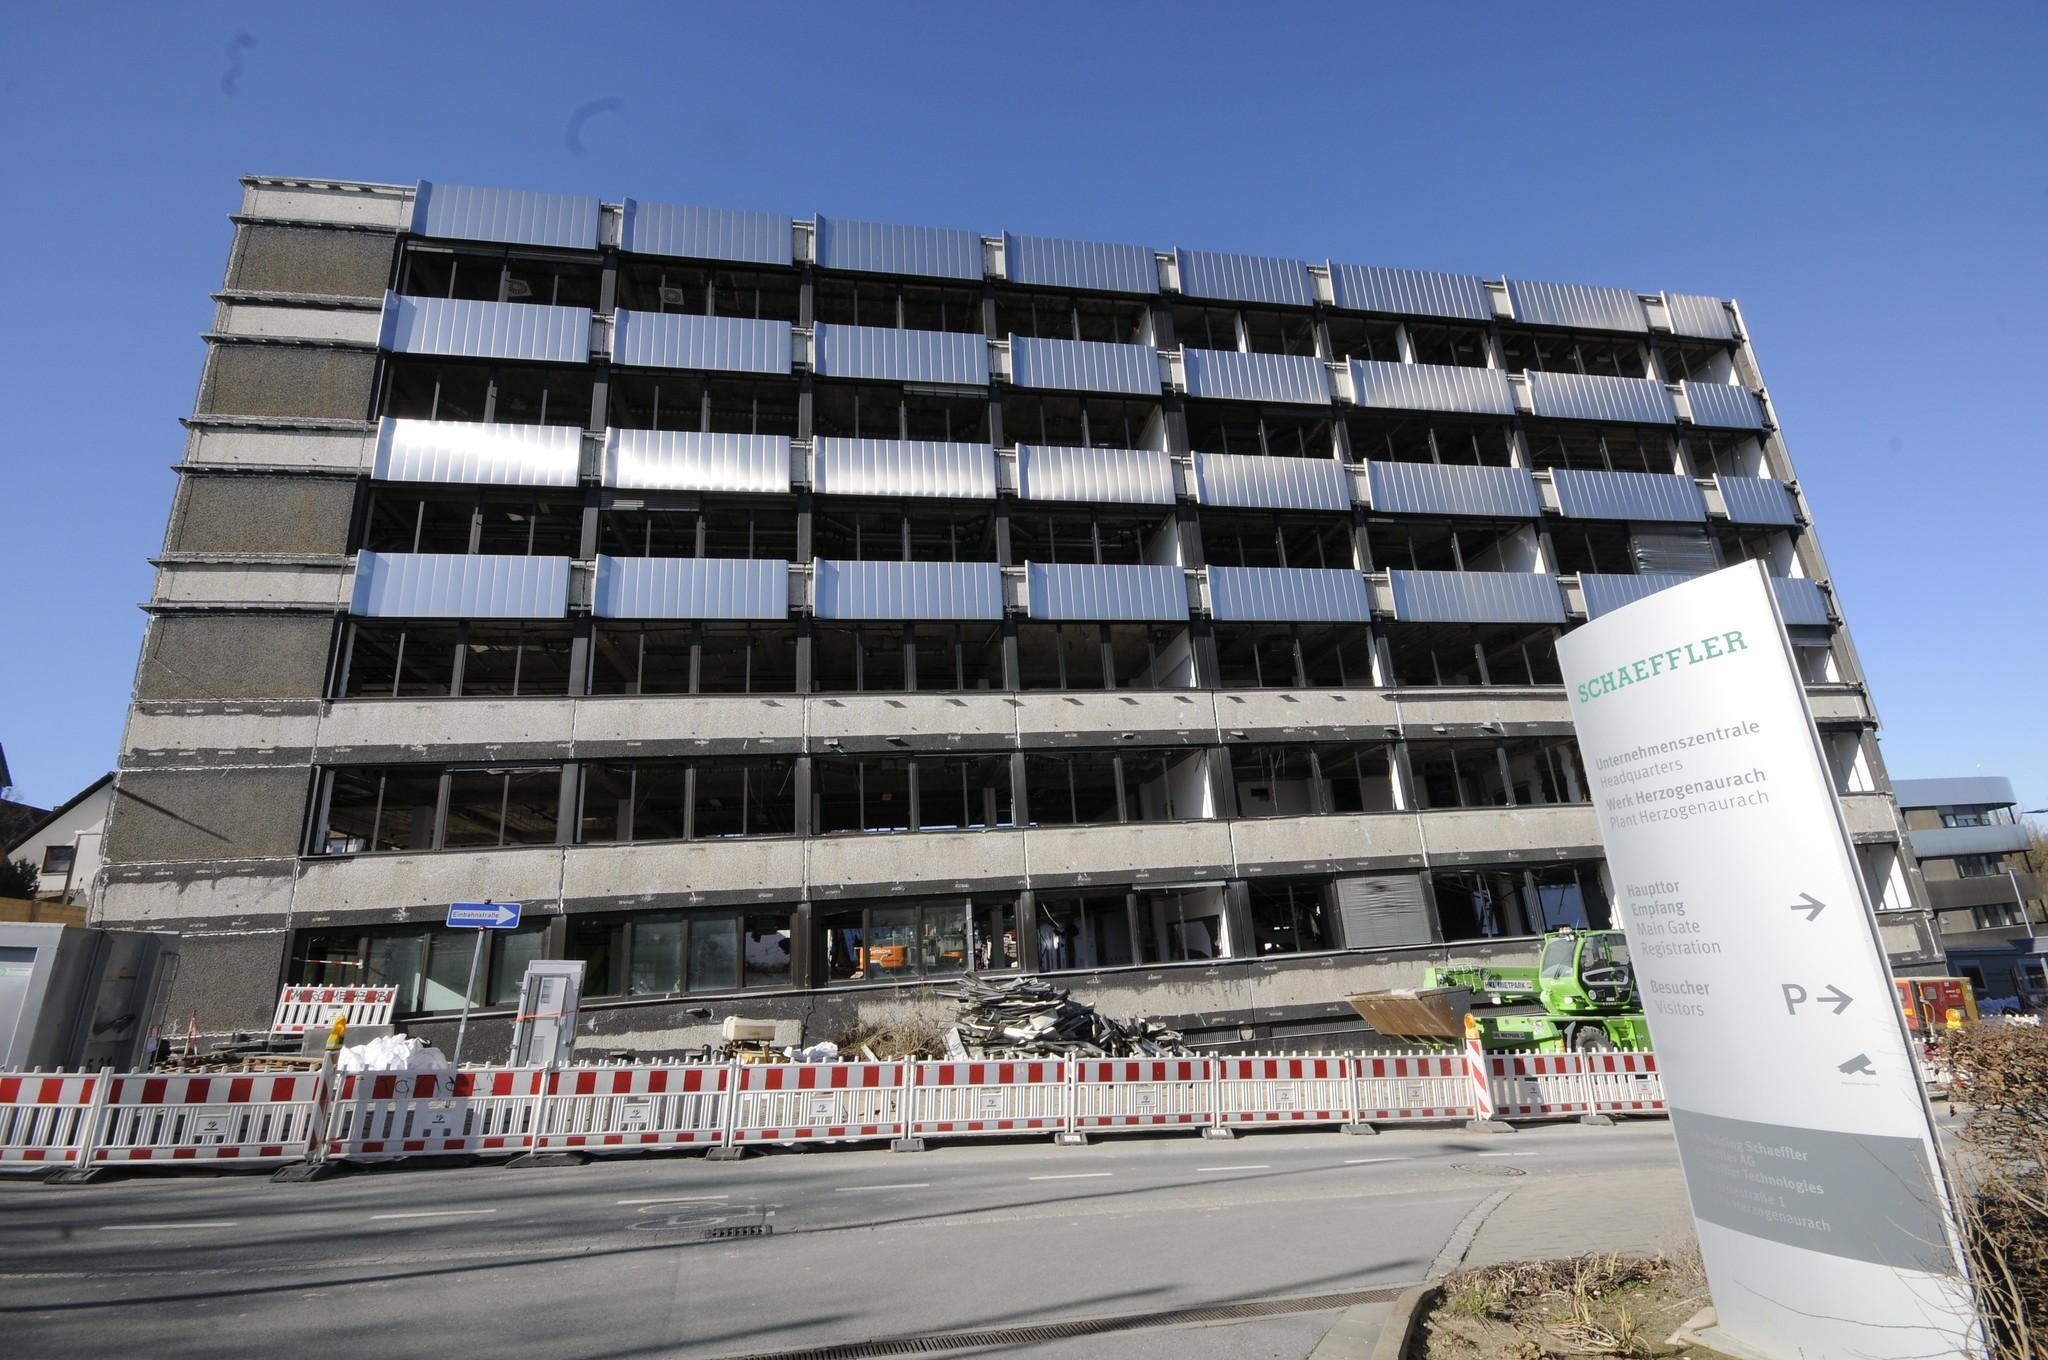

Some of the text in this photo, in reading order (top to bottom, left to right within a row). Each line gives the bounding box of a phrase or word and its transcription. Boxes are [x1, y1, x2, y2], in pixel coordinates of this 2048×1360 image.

[1578, 630, 1748, 704] SCHAEFFLER
[1595, 720, 1761, 771] Unternehmenszentrale
[1600, 759, 1684, 789] Headquarters
[1606, 768, 1767, 811] Werk Herzogenaurach
[1610, 790, 1770, 830] Plant Herzogenaurach
[1626, 880, 1680, 898] Haupttor
[1631, 900, 1686, 918] Empfang
[1637, 920, 1701, 936] Main Gate
[1640, 939, 1721, 958] Registration
[1650, 980, 1710, 996] Besucher
[1781, 983, 1807, 1016] P
[1655, 1000, 1705, 1017] Visitors
[1744, 1140, 1808, 1161] Schaeffler
[1742, 1168, 1825, 1195] Technologies
